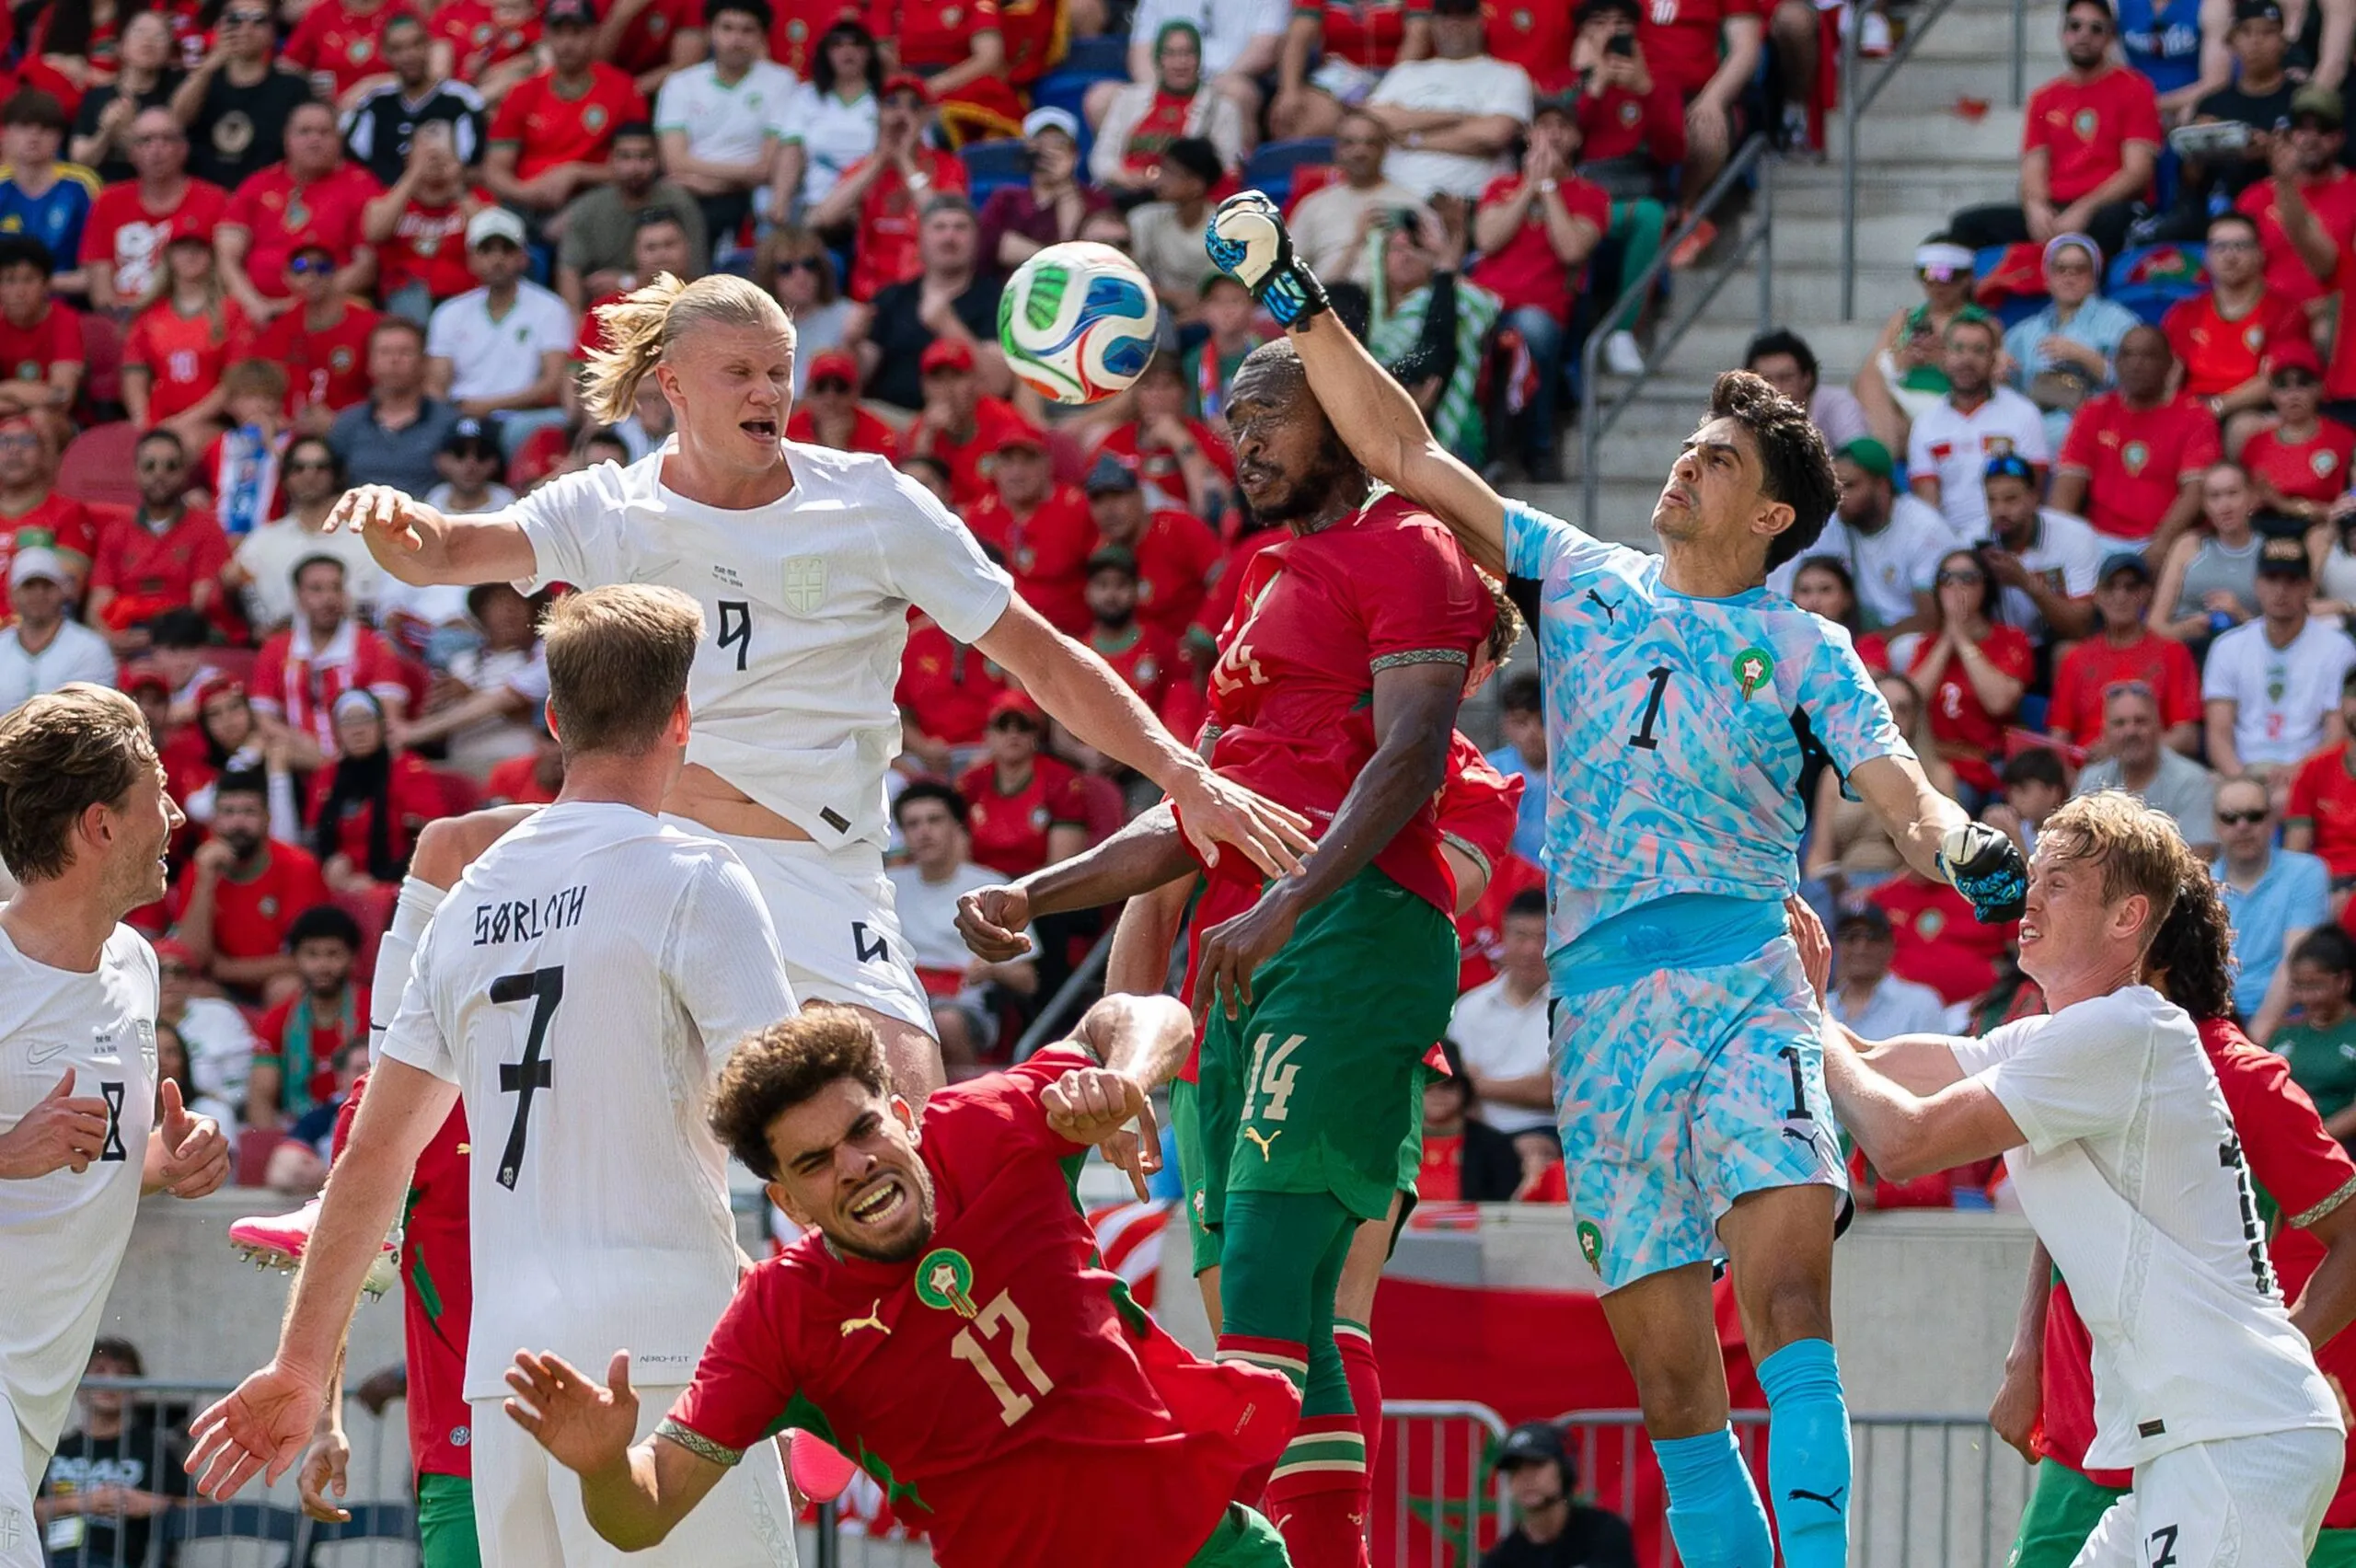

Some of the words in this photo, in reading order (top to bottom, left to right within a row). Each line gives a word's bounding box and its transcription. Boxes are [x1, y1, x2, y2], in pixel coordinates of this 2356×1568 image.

[717, 600, 751, 671] 9
[1628, 666, 1672, 751] 1
[490, 964, 564, 1193] 7
[1240, 1032, 1308, 1121] 14
[1777, 1045, 1814, 1120] 1
[951, 1286, 1056, 1428] 17
